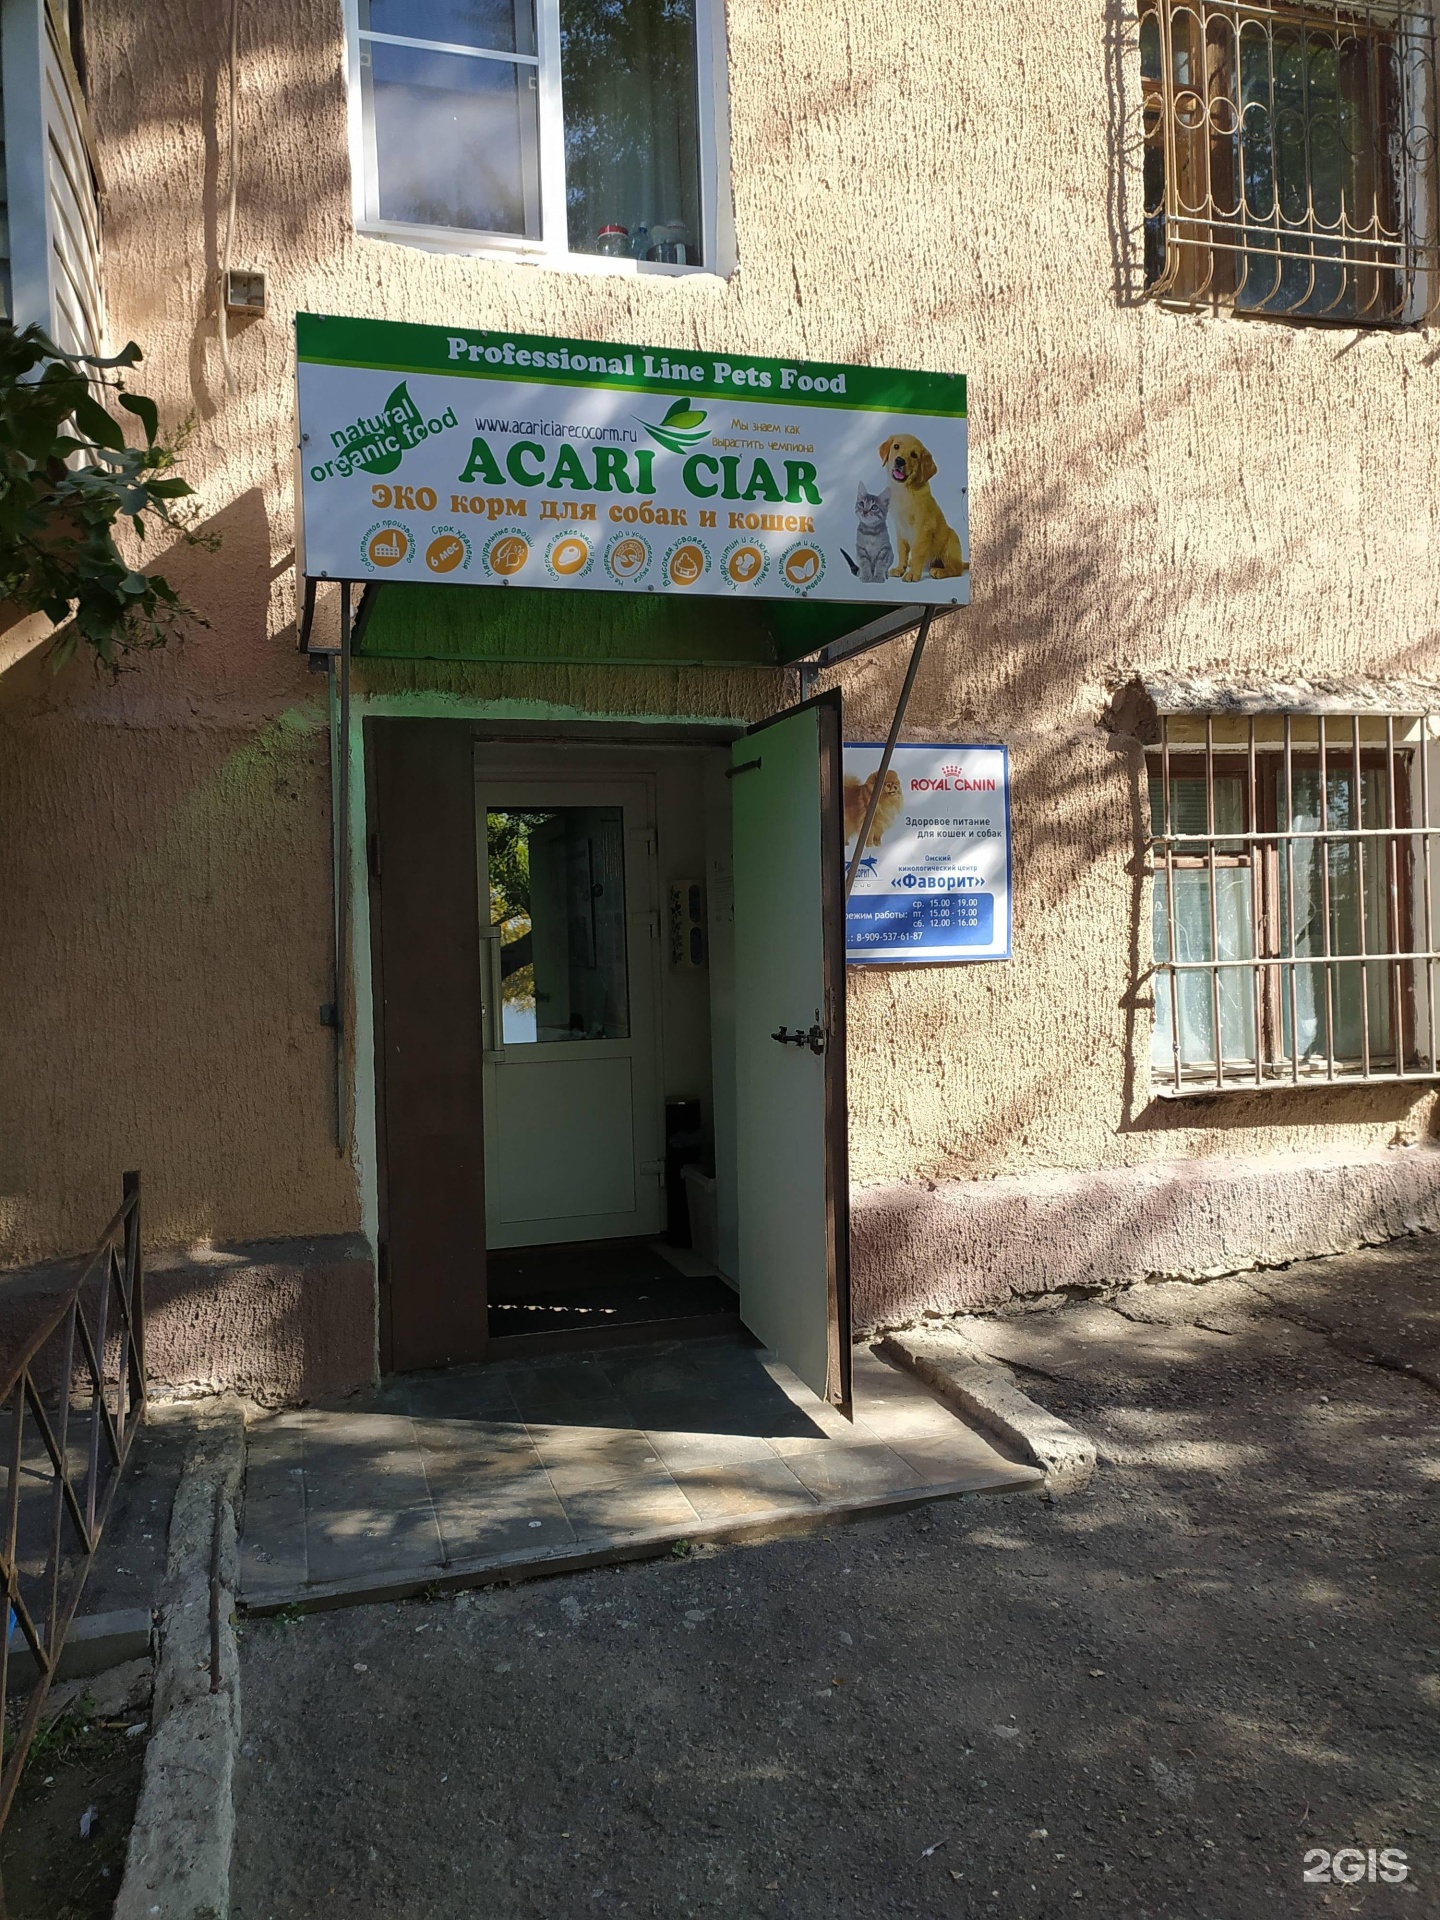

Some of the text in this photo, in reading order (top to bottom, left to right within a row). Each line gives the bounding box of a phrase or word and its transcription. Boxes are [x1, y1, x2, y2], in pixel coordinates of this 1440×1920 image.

[447, 337, 847, 394] Professional Line Pets Food
[329, 398, 414, 448] natural
[475, 416, 638, 443] www.acariciarecocorm.ru
[731, 418, 801, 435] Мы знаем как
[310, 406, 459, 482] organic food
[711, 436, 814, 453] вырастить чемпиона
[458, 437, 823, 505] ACARI CIAR
[371, 484, 816, 533] ЭКО корм для собак и кошек
[609, 530, 624, 544] ГМО
[359, 519, 416, 573] Собственное производство
[430, 542, 460, 567] 6 мес
[431, 525, 473, 570] Срок хранения
[481, 526, 535, 578] Натуральные овощи
[661, 547, 674, 588] Высокая
[672, 535, 713, 574] усвояемость
[911, 778, 996, 791] ROYAL CANIN
[905, 816, 991, 828] Здоровое питание
[917, 828, 1003, 840] для кошек и собак
[925, 854, 952, 862] Омский
[898, 864, 978, 873] кинологический центр
[912, 900, 925, 909] ср.
[929, 899, 950, 907] 15.00
[957, 898, 978, 907] 19.00
[874, 910, 908, 922] работы:
[912, 910, 925, 918] пт.
[929, 909, 950, 917] 15.00
[957, 908, 978, 917] 19.00
[912, 919, 925, 928] сб.
[929, 918, 950, 927] 12.00
[957, 918, 978, 927] 16.00
[856, 931, 923, 942] 8-909-537-61-87
